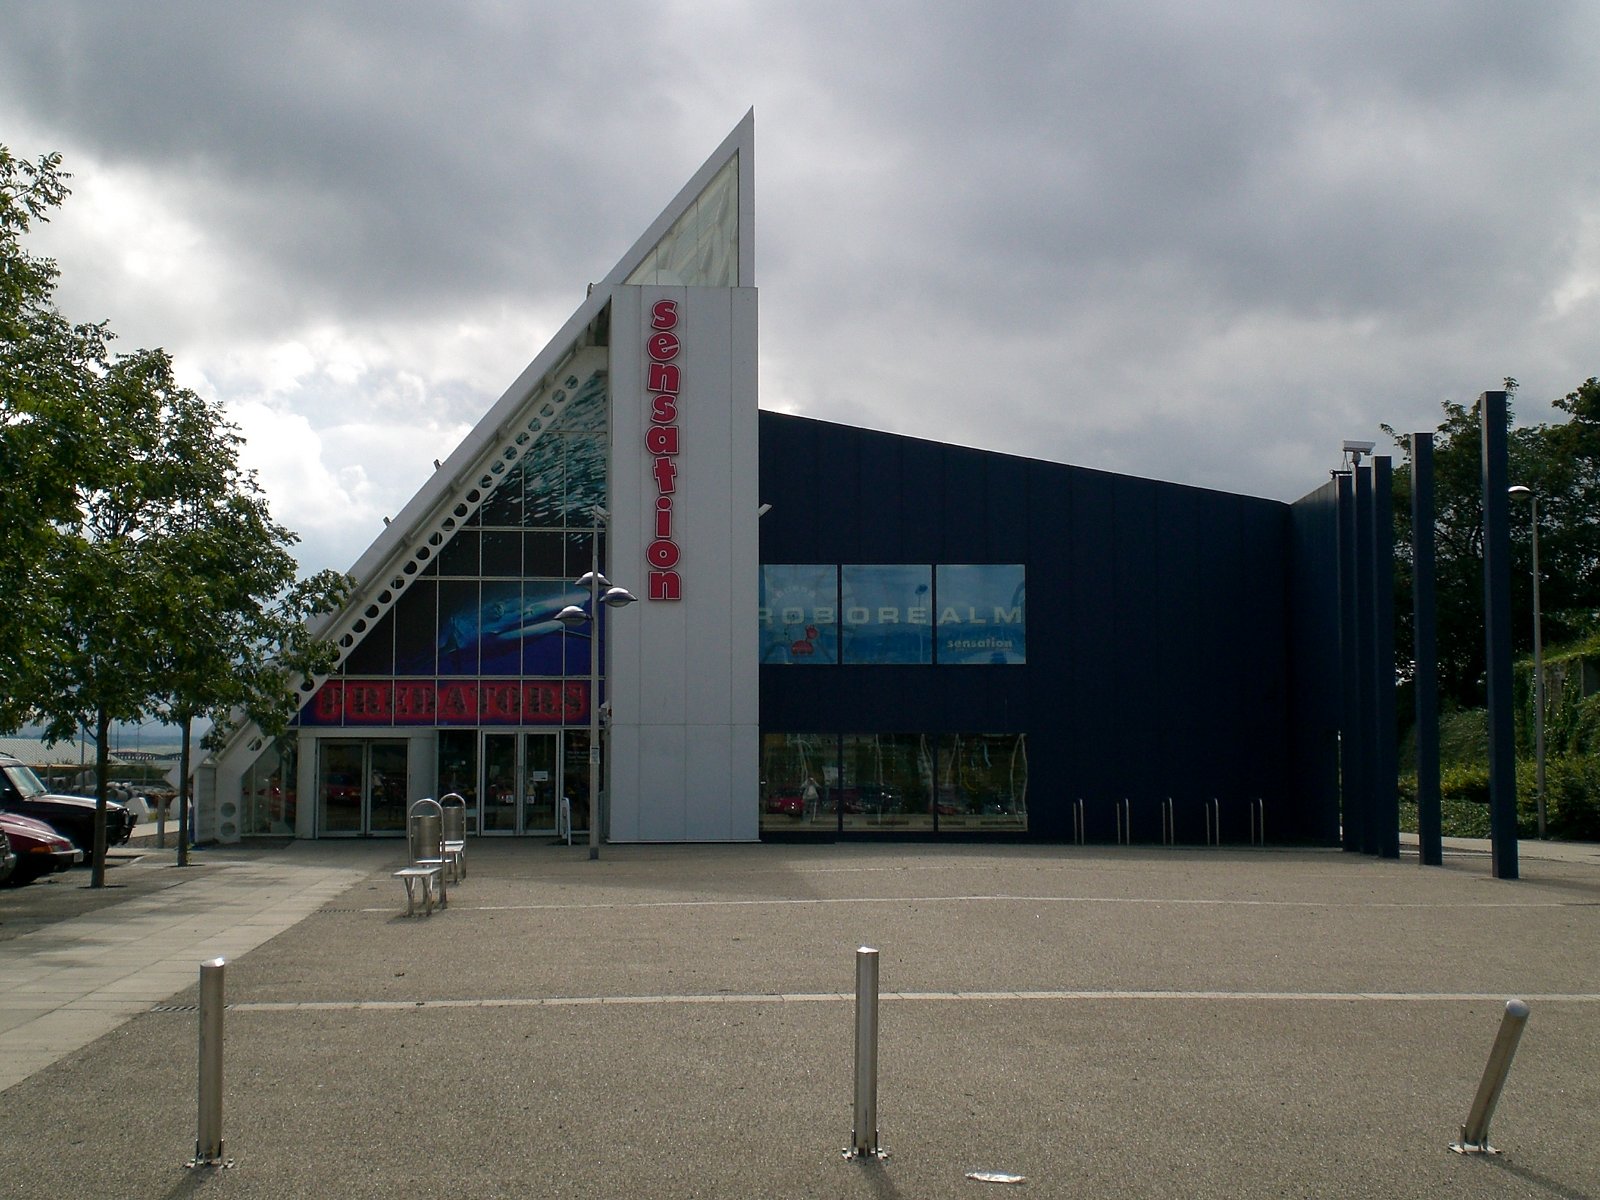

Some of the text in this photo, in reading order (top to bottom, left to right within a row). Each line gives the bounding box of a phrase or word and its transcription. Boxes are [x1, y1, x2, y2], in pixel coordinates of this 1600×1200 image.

[646, 299, 681, 600] sensation
[759, 606, 1023, 625] ROBOREALM
[946, 636, 1013, 649] sensation
[320, 685, 584, 716] PREDATORS
